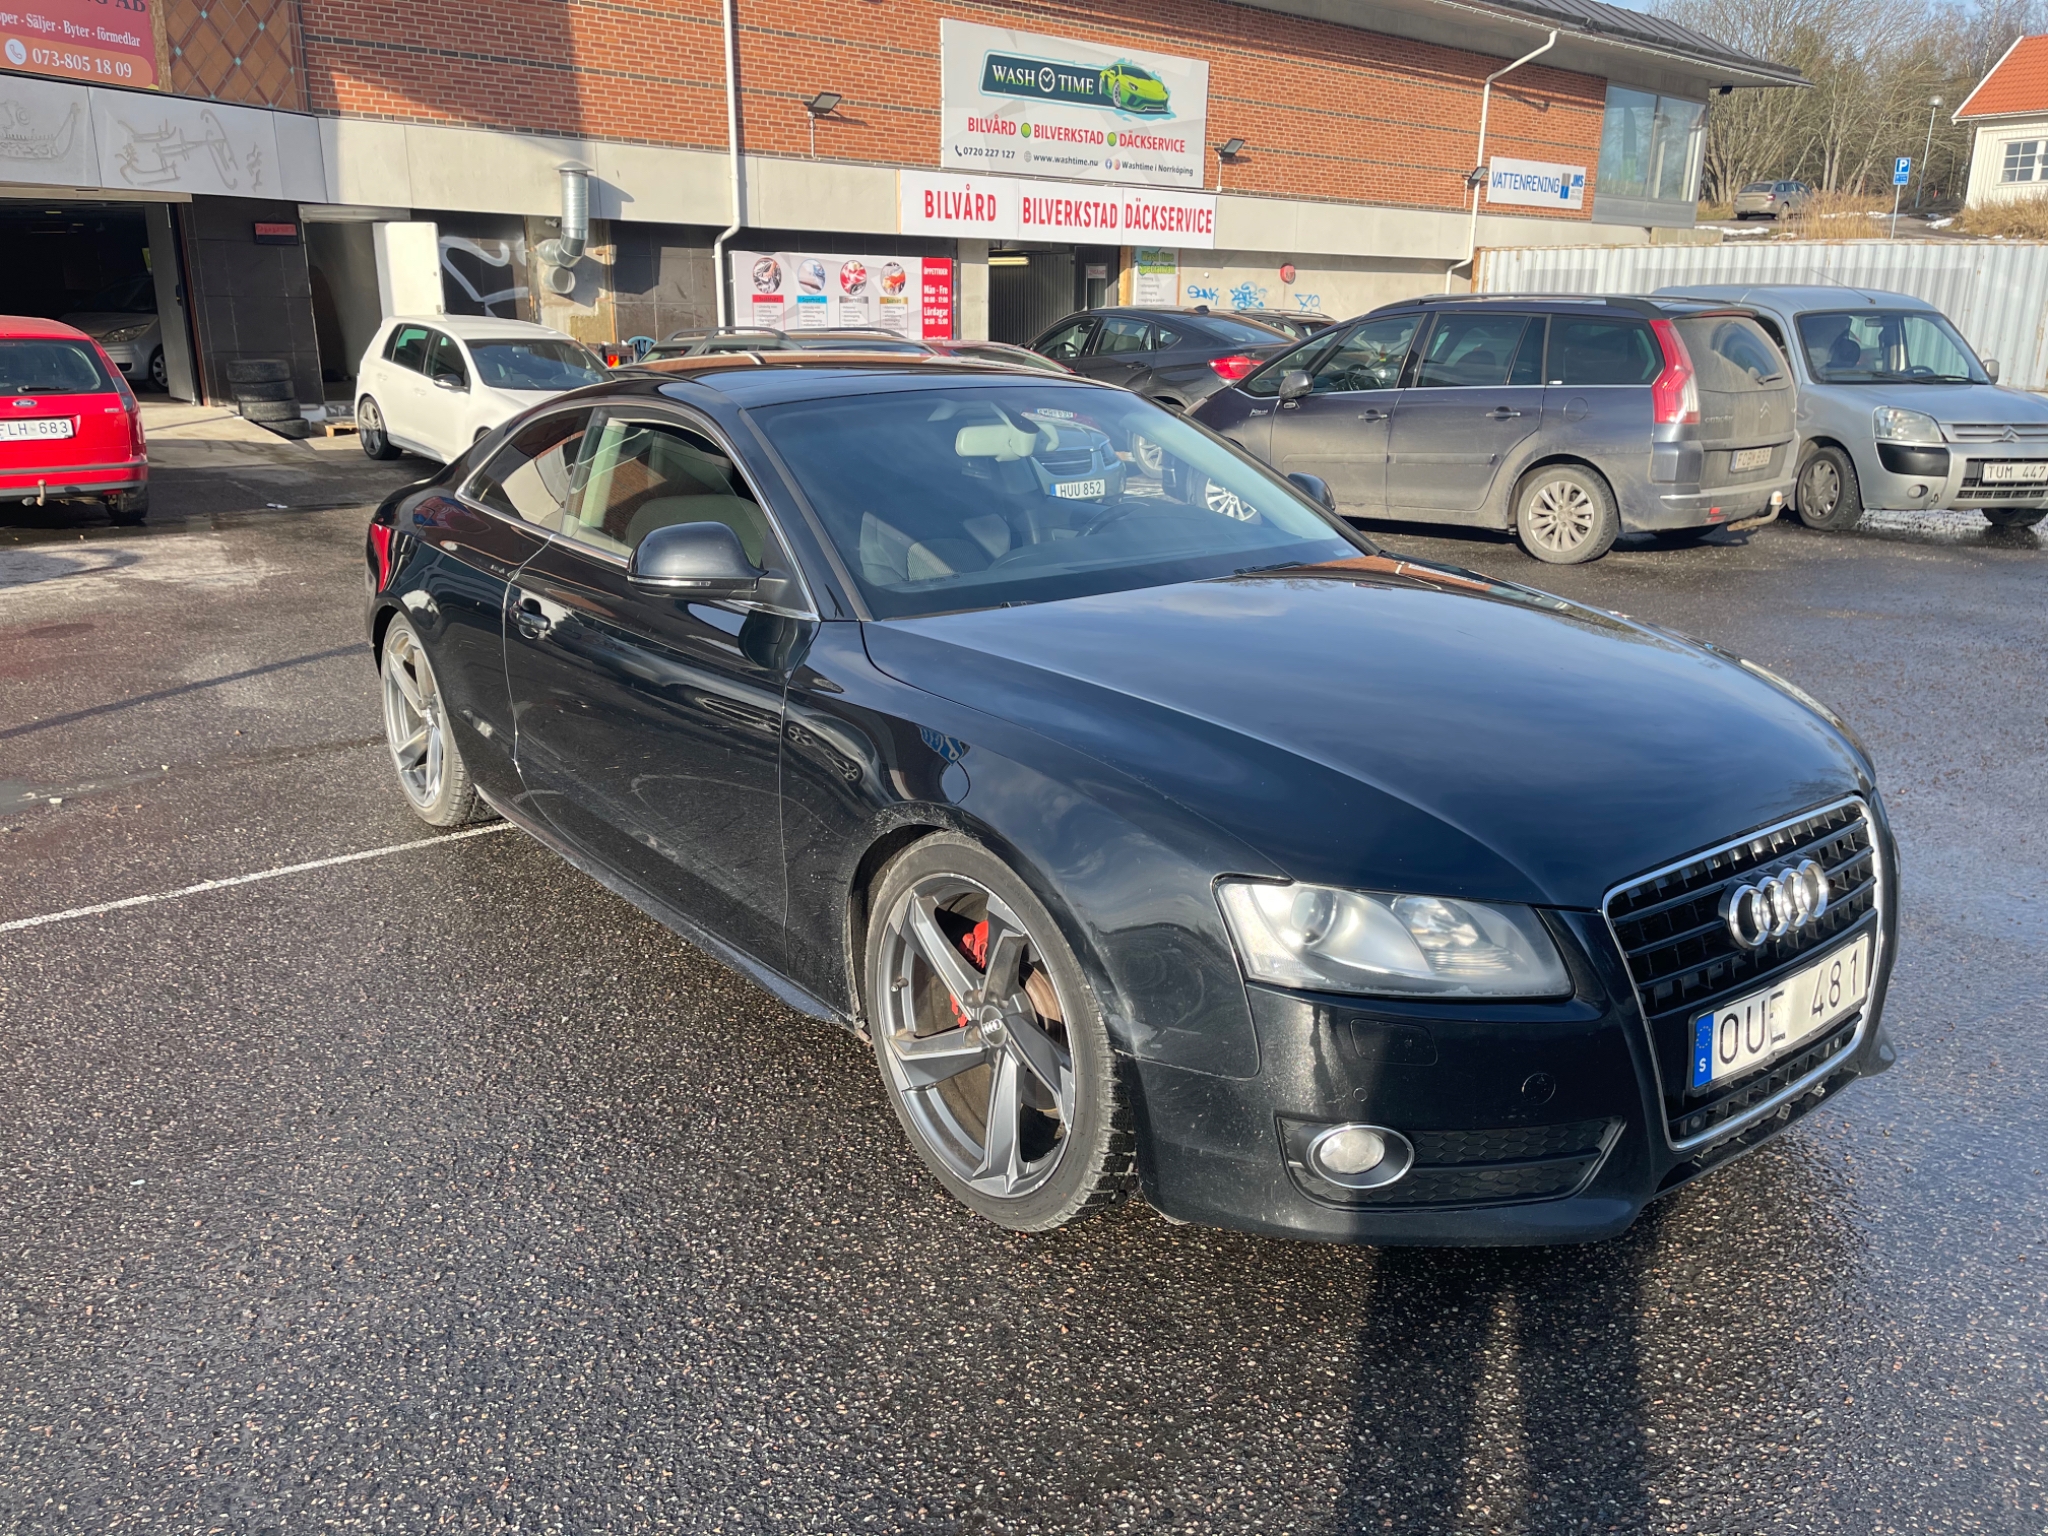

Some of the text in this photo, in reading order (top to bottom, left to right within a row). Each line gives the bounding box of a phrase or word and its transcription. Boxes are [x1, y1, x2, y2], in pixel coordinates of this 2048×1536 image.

[26, 13, 56, 33] Säljer
[64, 20, 90, 39] Byter
[97, 26, 141, 47] förmedlar
[32, 48, 132, 78] 073-805 18 09
[992, 64, 1094, 95] WASH TIME
[967, 114, 1186, 153] BILVÅRD BILVERKSTAD DÄCKSERVICE
[963, 146, 1016, 159] 0720 227 127
[1033, 152, 1099, 167] www.washtime.nu
[1121, 160, 1154, 172] Washtime
[1158, 163, 1194, 177] Norrköping
[1898, 160, 1908, 172] P
[1492, 171, 1560, 194] VATTENRENING
[924, 183, 1213, 234] BILVÅRD BILVERKSTAD DÄCKSERVICE
[939, 285, 949, 295] Fre
[923, 306, 949, 318] Lördagar
[38, 421, 68, 434] 683
[1988, 466, 2047, 478] TUM 447
[1060, 480, 1102, 498] HUU 852
[1718, 949, 1859, 1065] OUE 481
[1699, 1057, 1706, 1072] S
